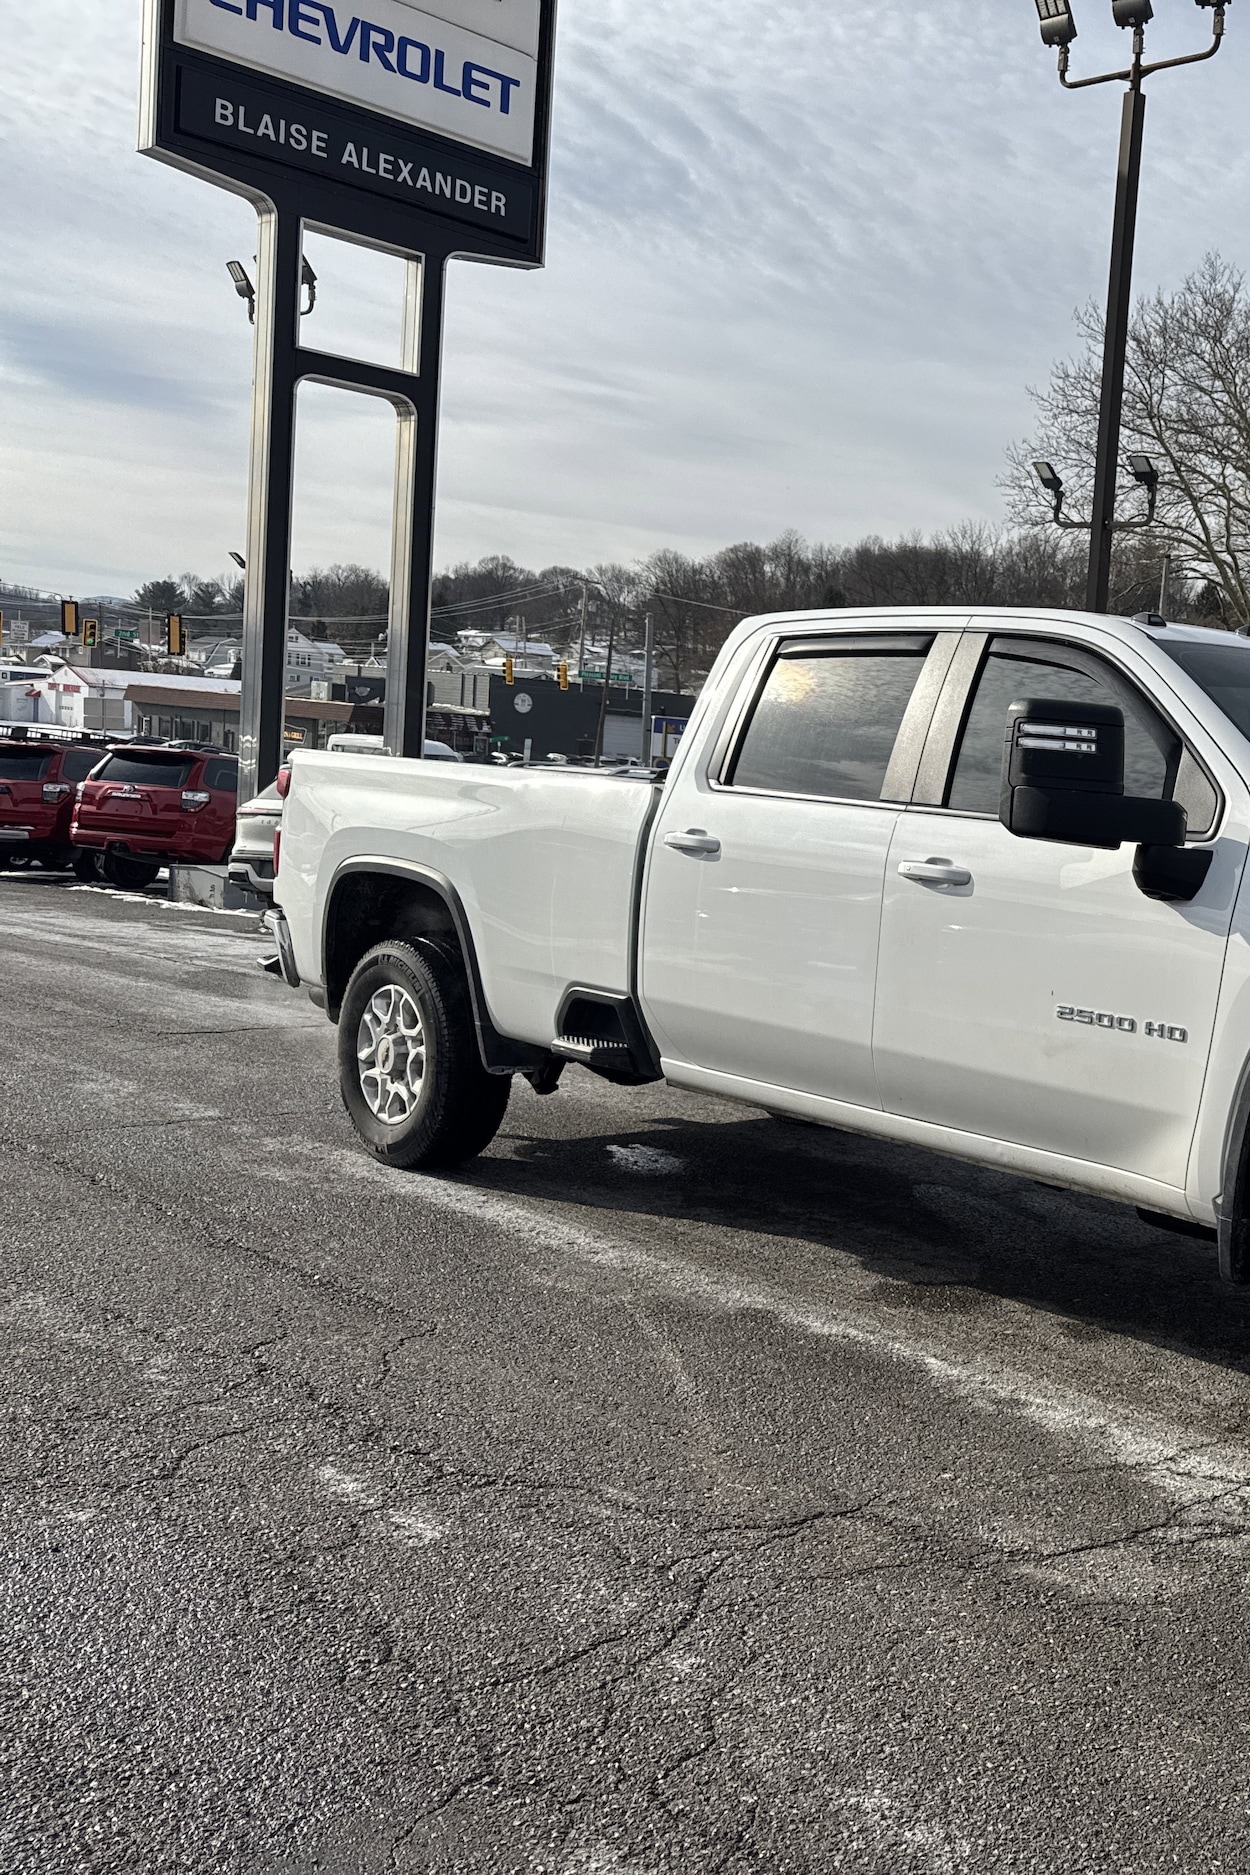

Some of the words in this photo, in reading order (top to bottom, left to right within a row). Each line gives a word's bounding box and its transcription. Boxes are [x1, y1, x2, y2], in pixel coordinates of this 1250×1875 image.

[214, 97, 329, 158] BLAISE
[341, 142, 507, 217] ALEXANDER
[118, 629, 131, 638] 2nd
[388, 955, 422, 991] MICHELIN
[1056, 1003, 1137, 1033] 2500
[1144, 1020, 1189, 1044] HD
